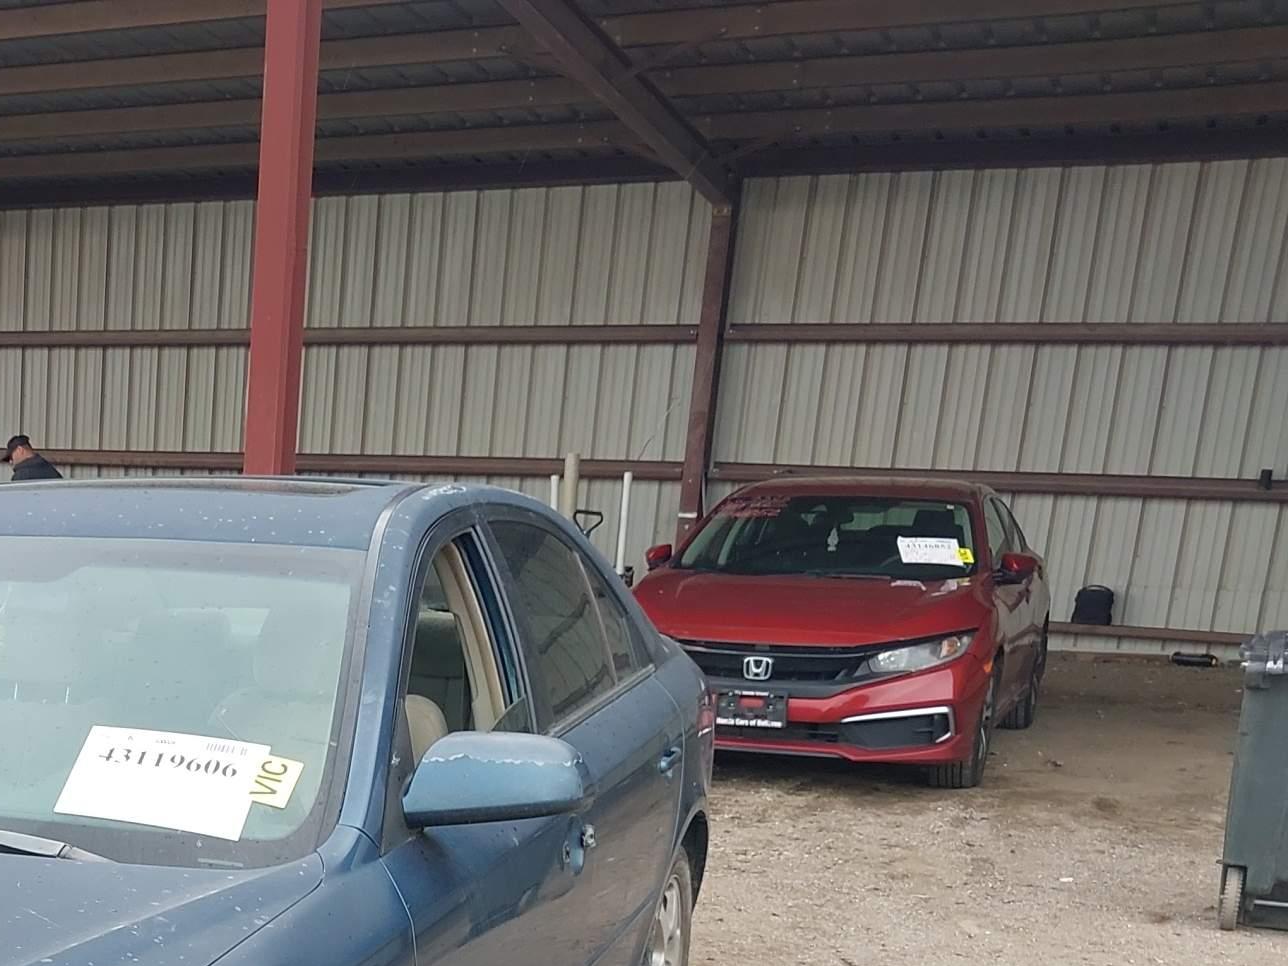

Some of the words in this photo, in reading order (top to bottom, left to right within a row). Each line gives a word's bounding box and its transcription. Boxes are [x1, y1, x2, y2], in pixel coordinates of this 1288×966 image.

[735, 718, 749, 726] Cars
[98, 747, 237, 778] 43119606
[248, 760, 289, 796] VIC
